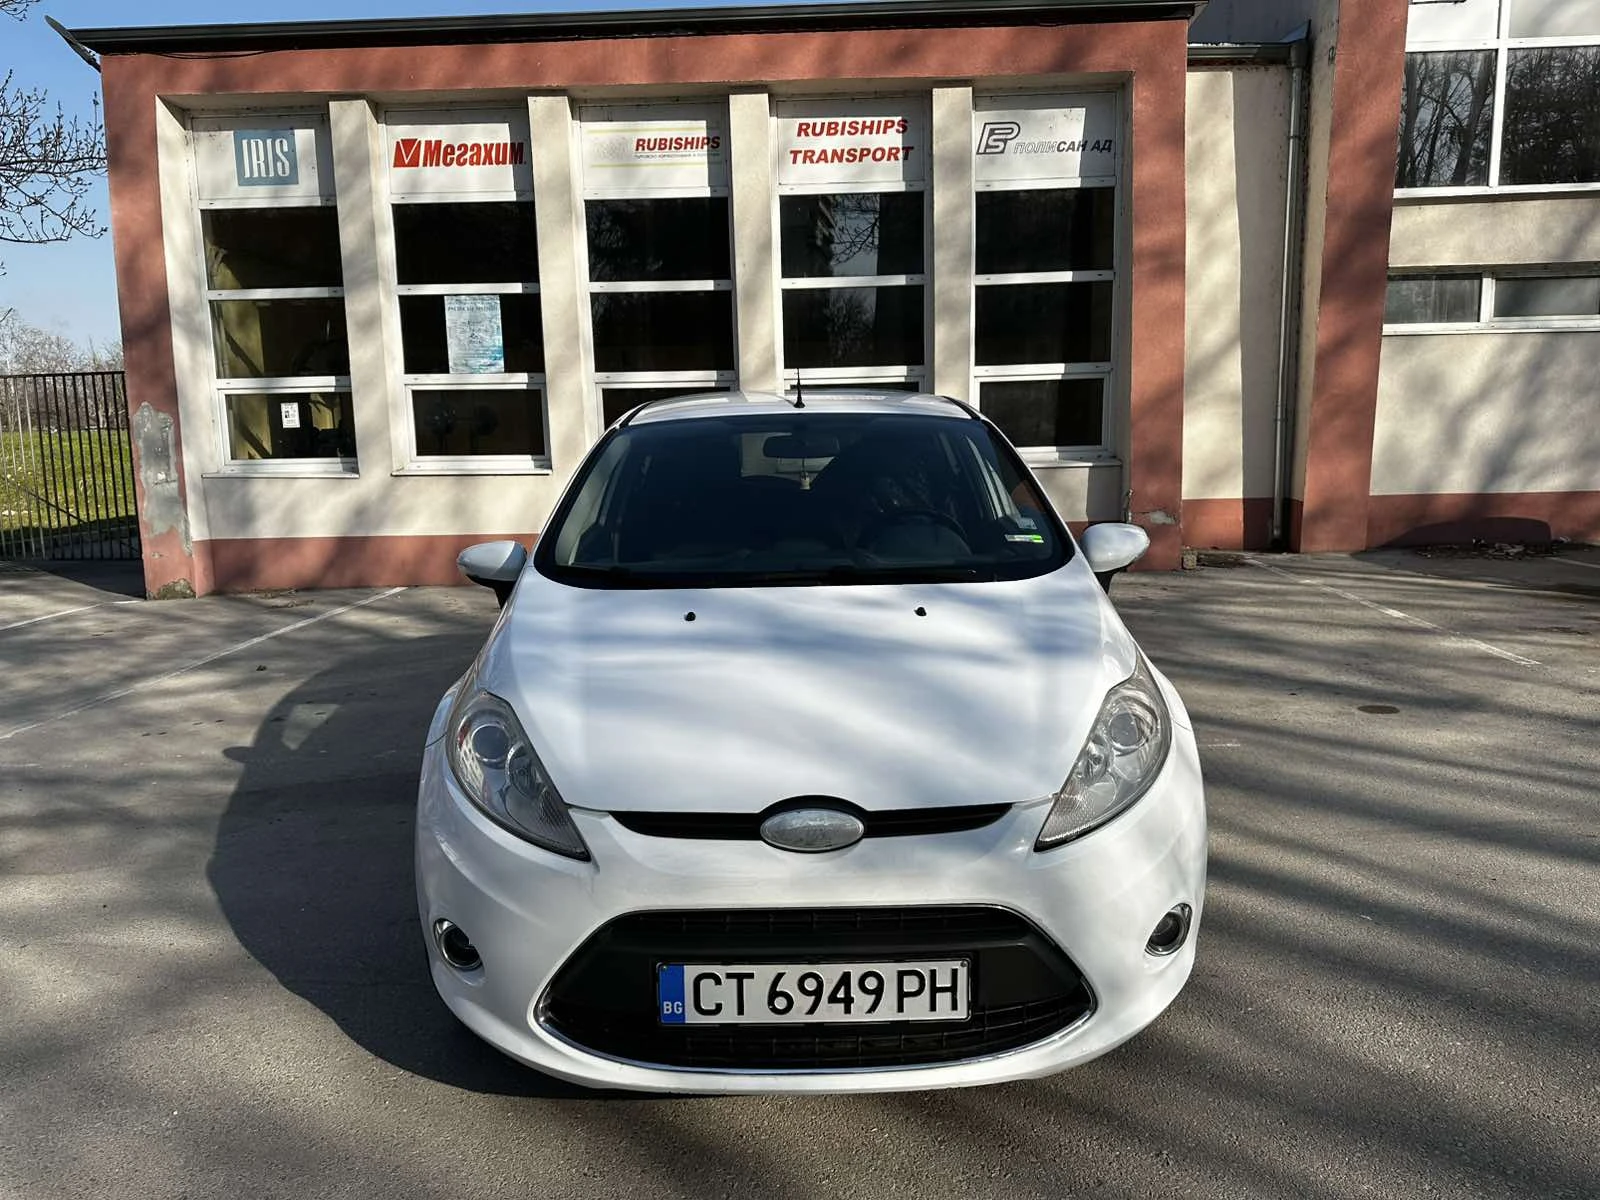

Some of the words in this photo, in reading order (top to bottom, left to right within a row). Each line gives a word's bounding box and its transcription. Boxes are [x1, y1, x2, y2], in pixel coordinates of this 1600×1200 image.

[796, 118, 908, 137] RUBISHIPS
[635, 136, 720, 151] RUBISHIPS
[1013, 140, 1088, 154] ПОЛИСАН
[1090, 139, 1113, 153] АД
[241, 136, 291, 178] IRIS
[789, 146, 914, 165] TRANSPORT
[692, 971, 755, 1017] CT
[766, 969, 885, 1016] 6949
[896, 967, 959, 1014] PH
[663, 1001, 683, 1015] BG
